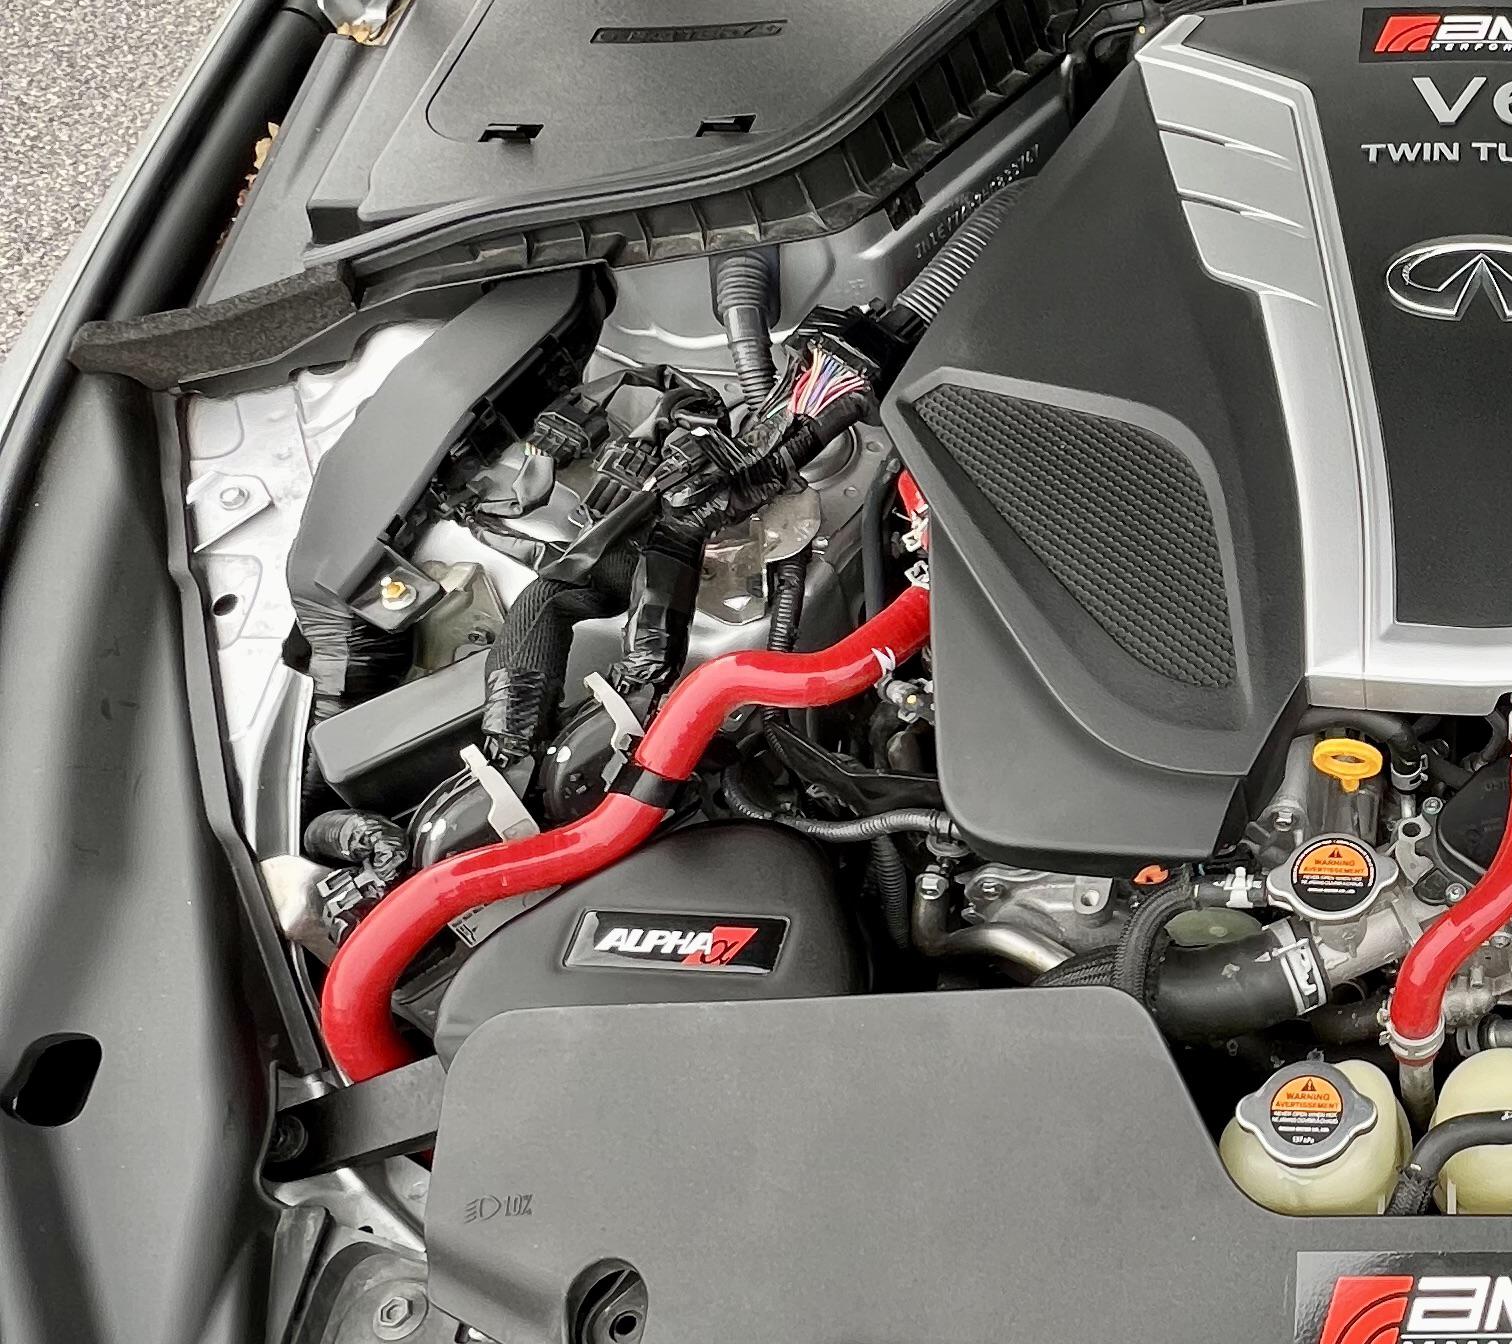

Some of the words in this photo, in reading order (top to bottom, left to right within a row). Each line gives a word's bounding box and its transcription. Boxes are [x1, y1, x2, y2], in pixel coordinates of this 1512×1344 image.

[1360, 141, 1461, 165] TWIN
[594, 927, 714, 955] ALPHA
[1286, 1093, 1331, 1101] WARNING
